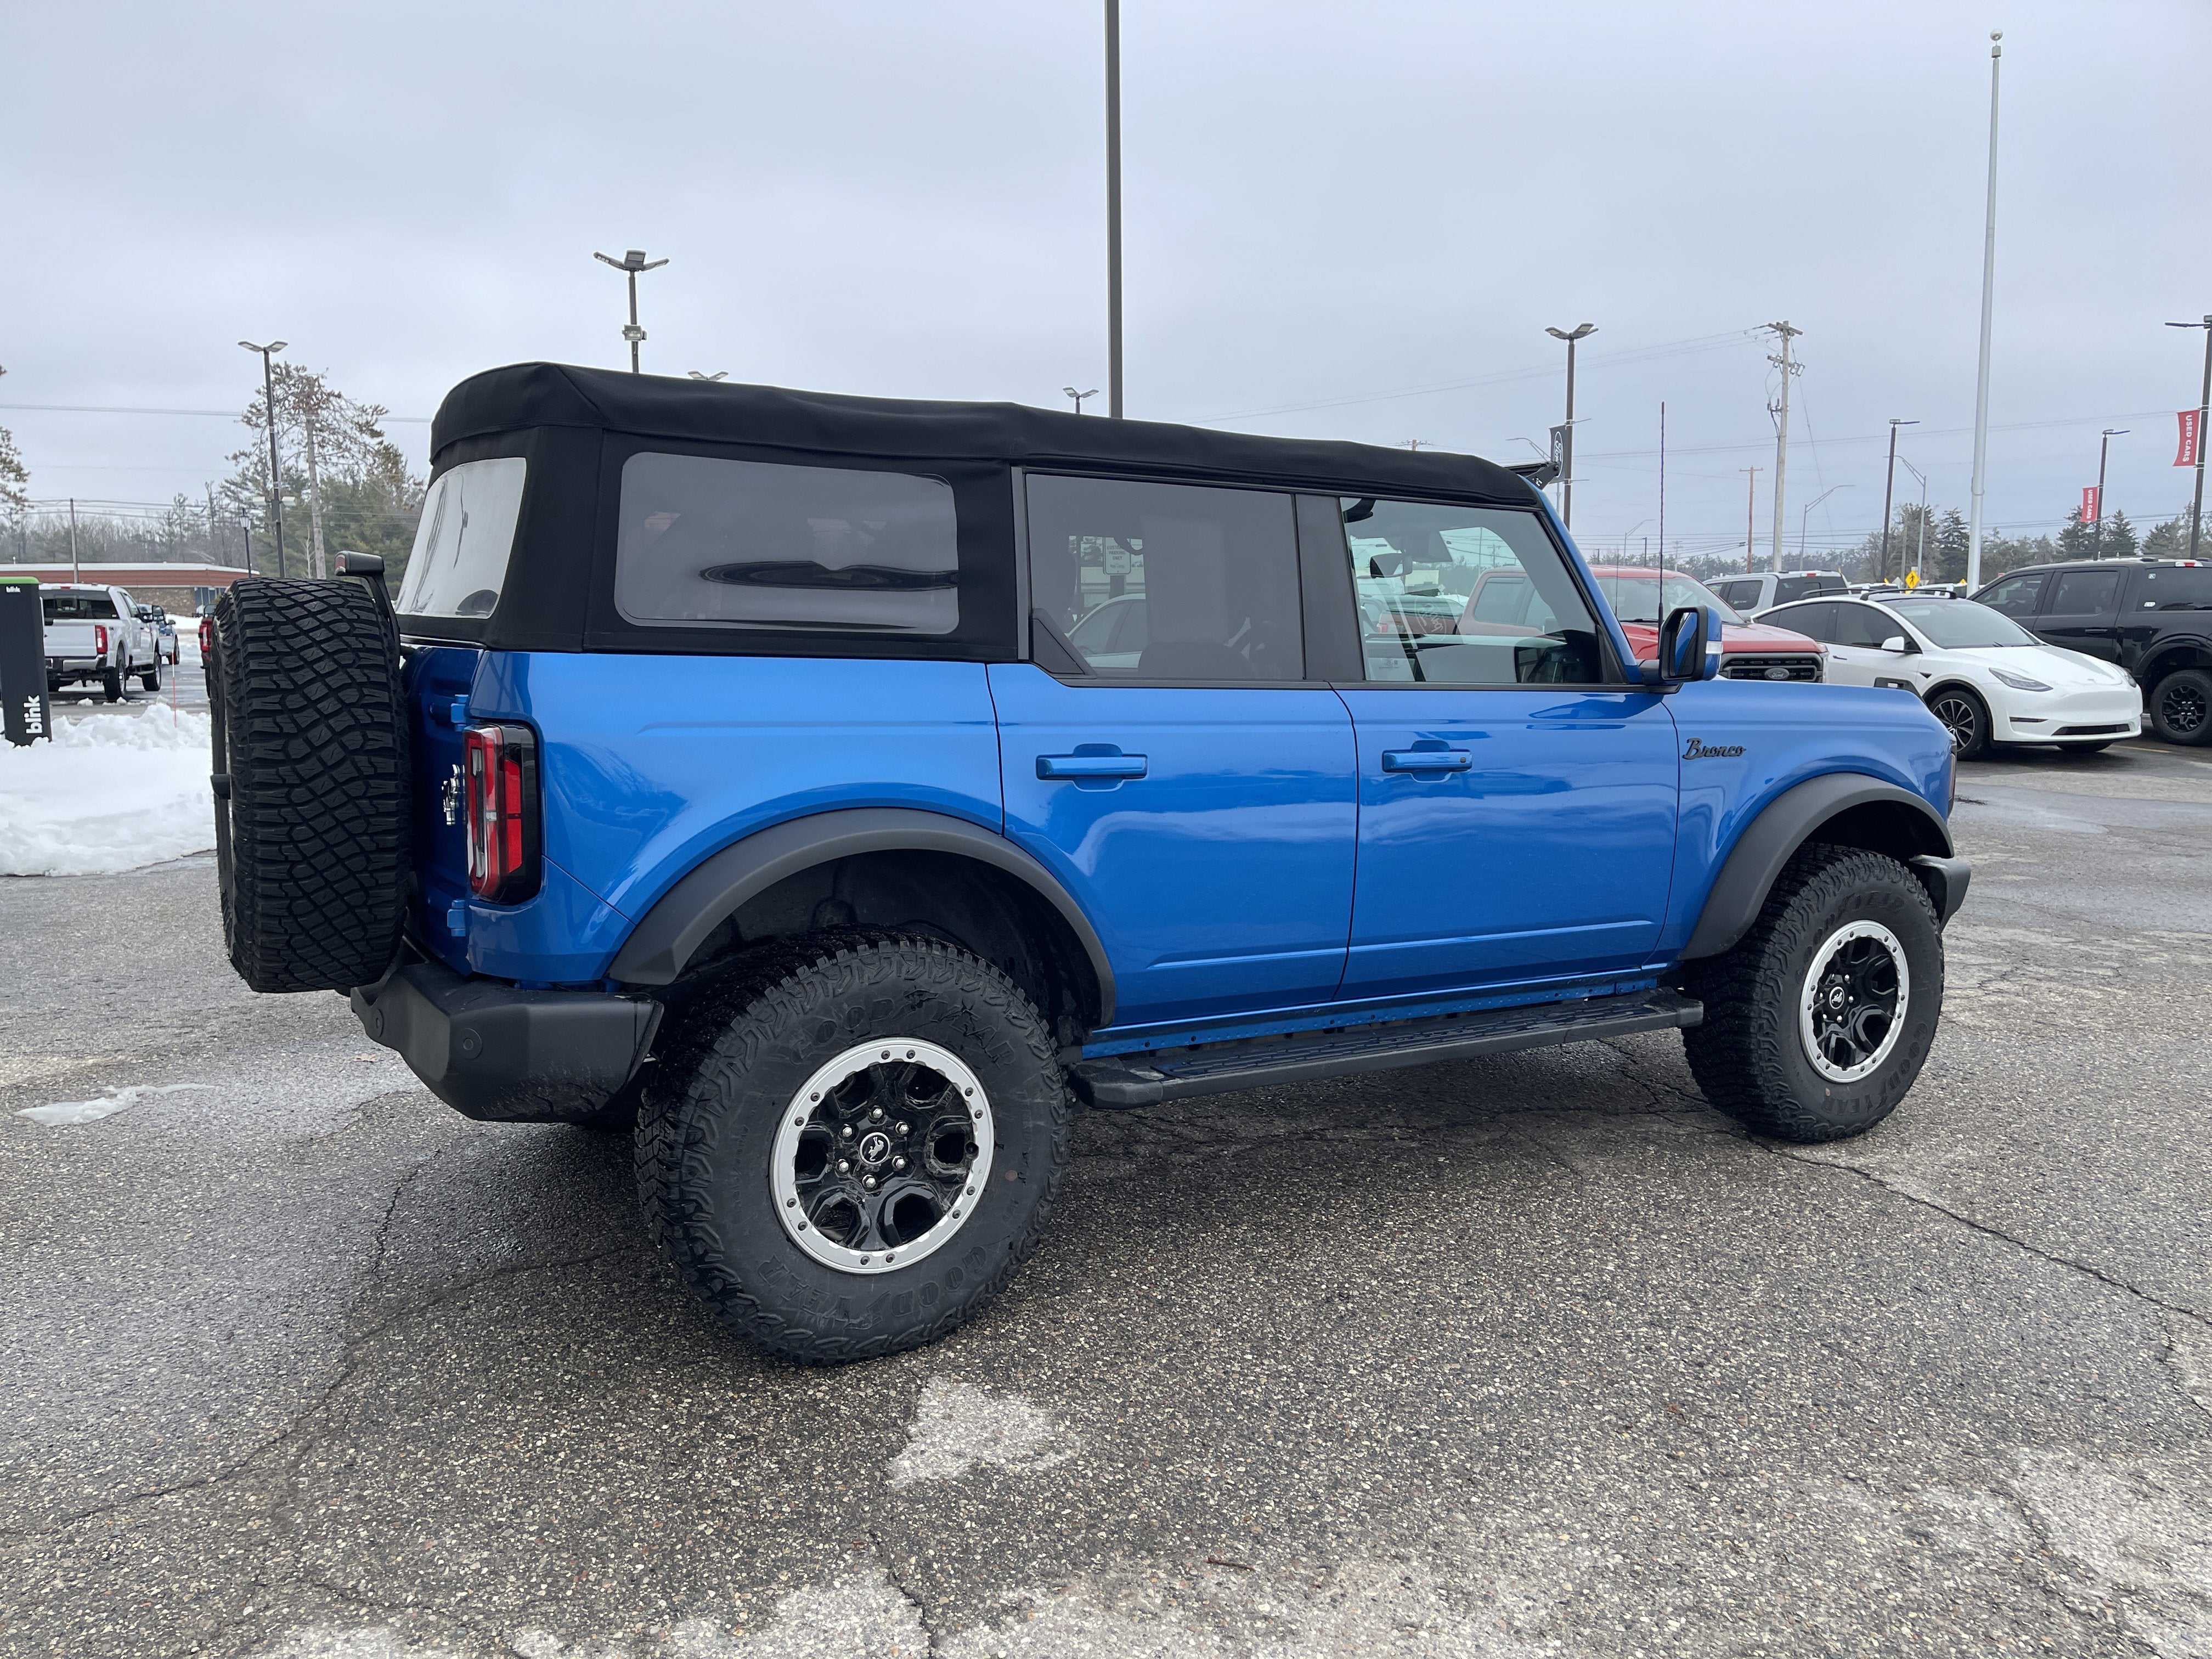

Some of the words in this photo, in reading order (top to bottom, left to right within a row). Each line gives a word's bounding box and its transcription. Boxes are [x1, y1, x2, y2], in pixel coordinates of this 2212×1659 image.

[2182, 439, 2192, 462] CARS
[24, 695, 42, 733] blink
[1682, 737, 1747, 760] Bronco
[789, 993, 1017, 1066] GOODYEAR
[1821, 1023, 1928, 1115] GOODYEAR
[758, 1245, 987, 1328] GOODYEAR
